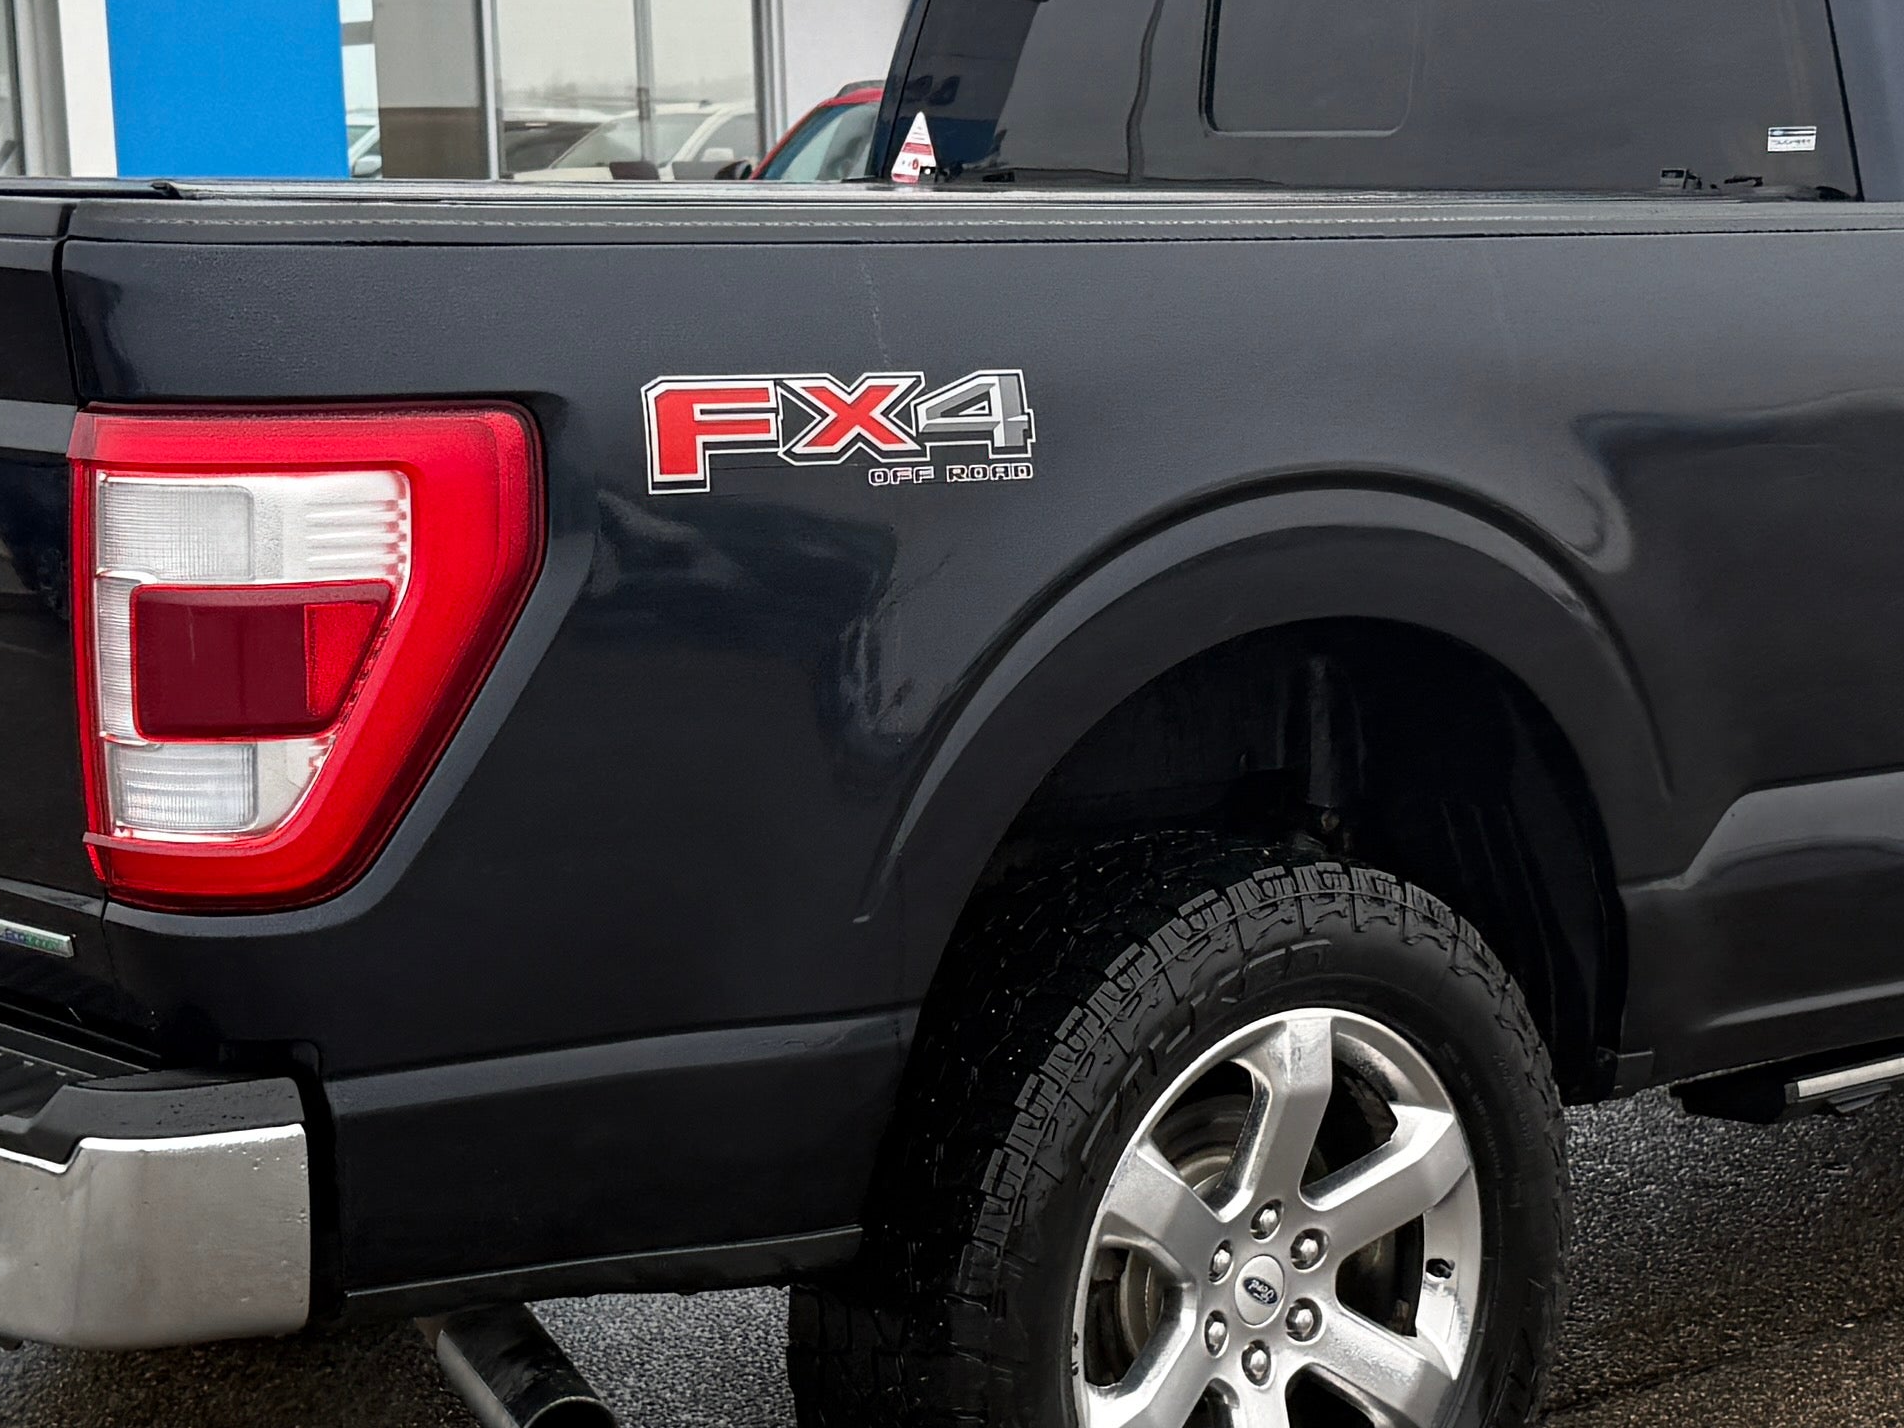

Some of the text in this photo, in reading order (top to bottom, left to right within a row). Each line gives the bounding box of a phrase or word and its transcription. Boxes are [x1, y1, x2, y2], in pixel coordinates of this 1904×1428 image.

[641, 369, 1035, 495] FX4
[868, 462, 1034, 486] OFF ROAD
